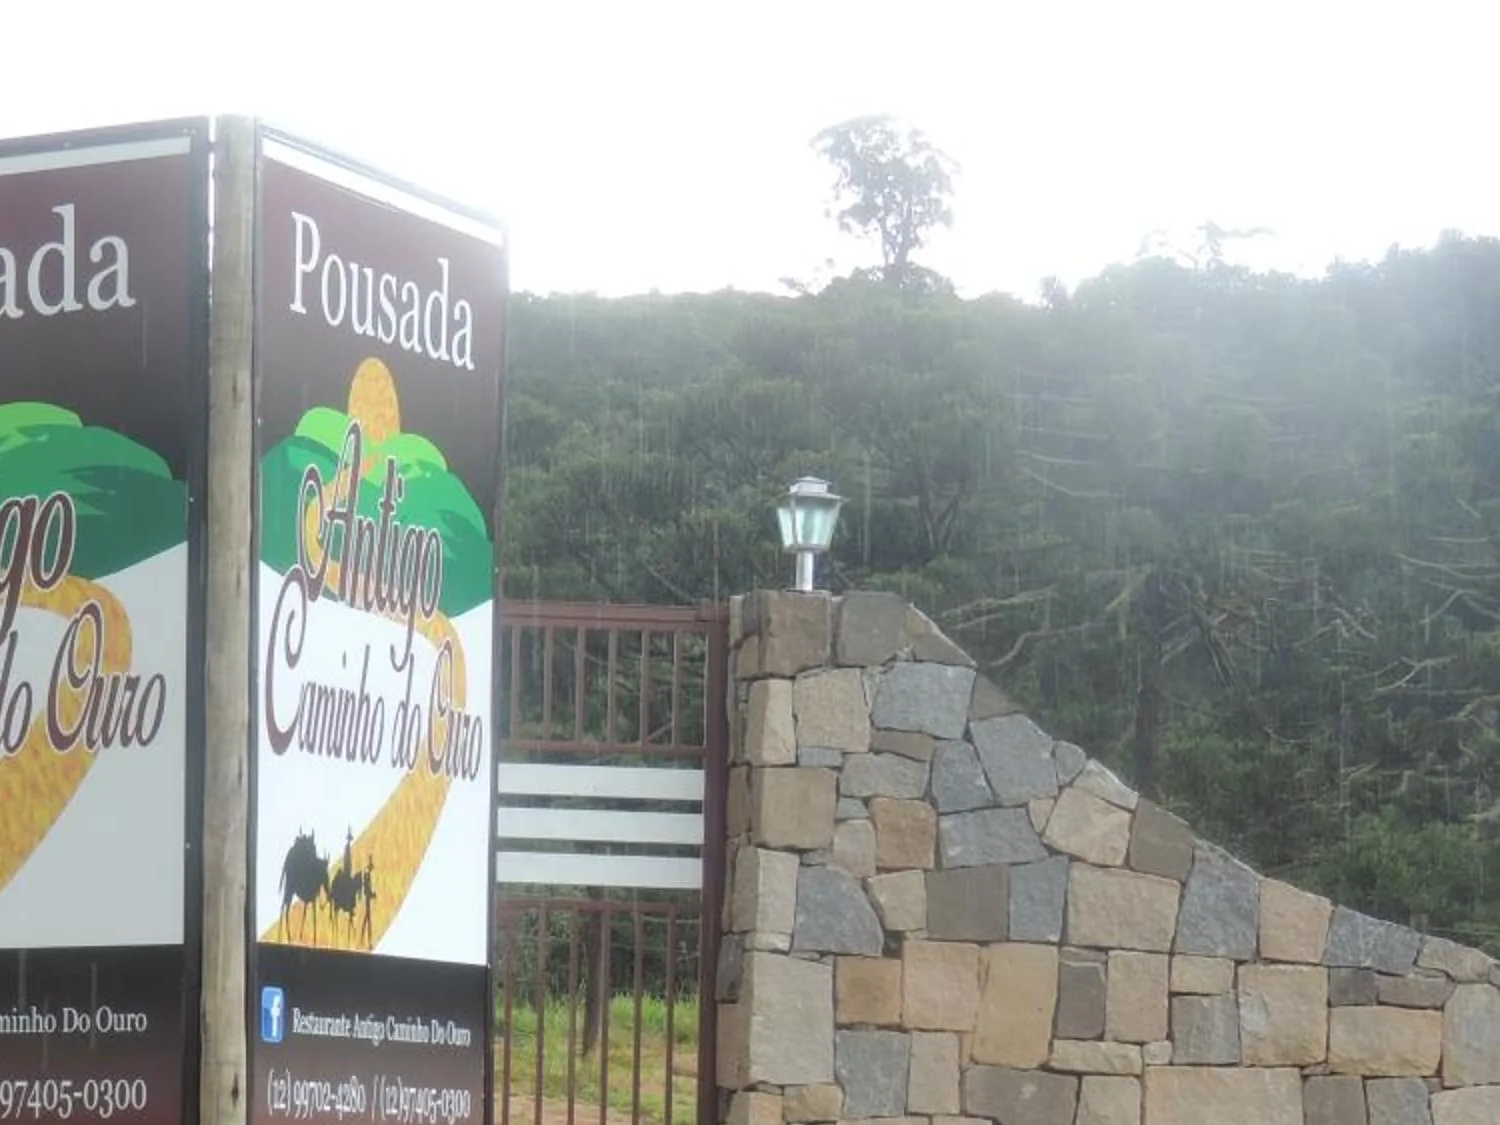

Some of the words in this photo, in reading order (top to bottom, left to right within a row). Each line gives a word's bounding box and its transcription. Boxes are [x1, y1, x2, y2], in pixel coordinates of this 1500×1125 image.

[289, 211, 476, 371] Pousada
[296, 419, 444, 674] Antigo
[47, 602, 167, 754] Ouro
[265, 565, 385, 758] Caminho
[391, 652, 421, 771] do
[428, 640, 484, 782] Ouro
[62, 1007, 91, 1033] Do
[95, 1006, 148, 1033] Ouro
[292, 1007, 351, 1037] Restaurante
[352, 1013, 385, 1047] Antigo
[386, 1015, 429, 1043] Caminho
[431, 1019, 445, 1044] Do
[446, 1021, 471, 1047] Ouro
[294, 1075, 366, 1120] 99702-4280
